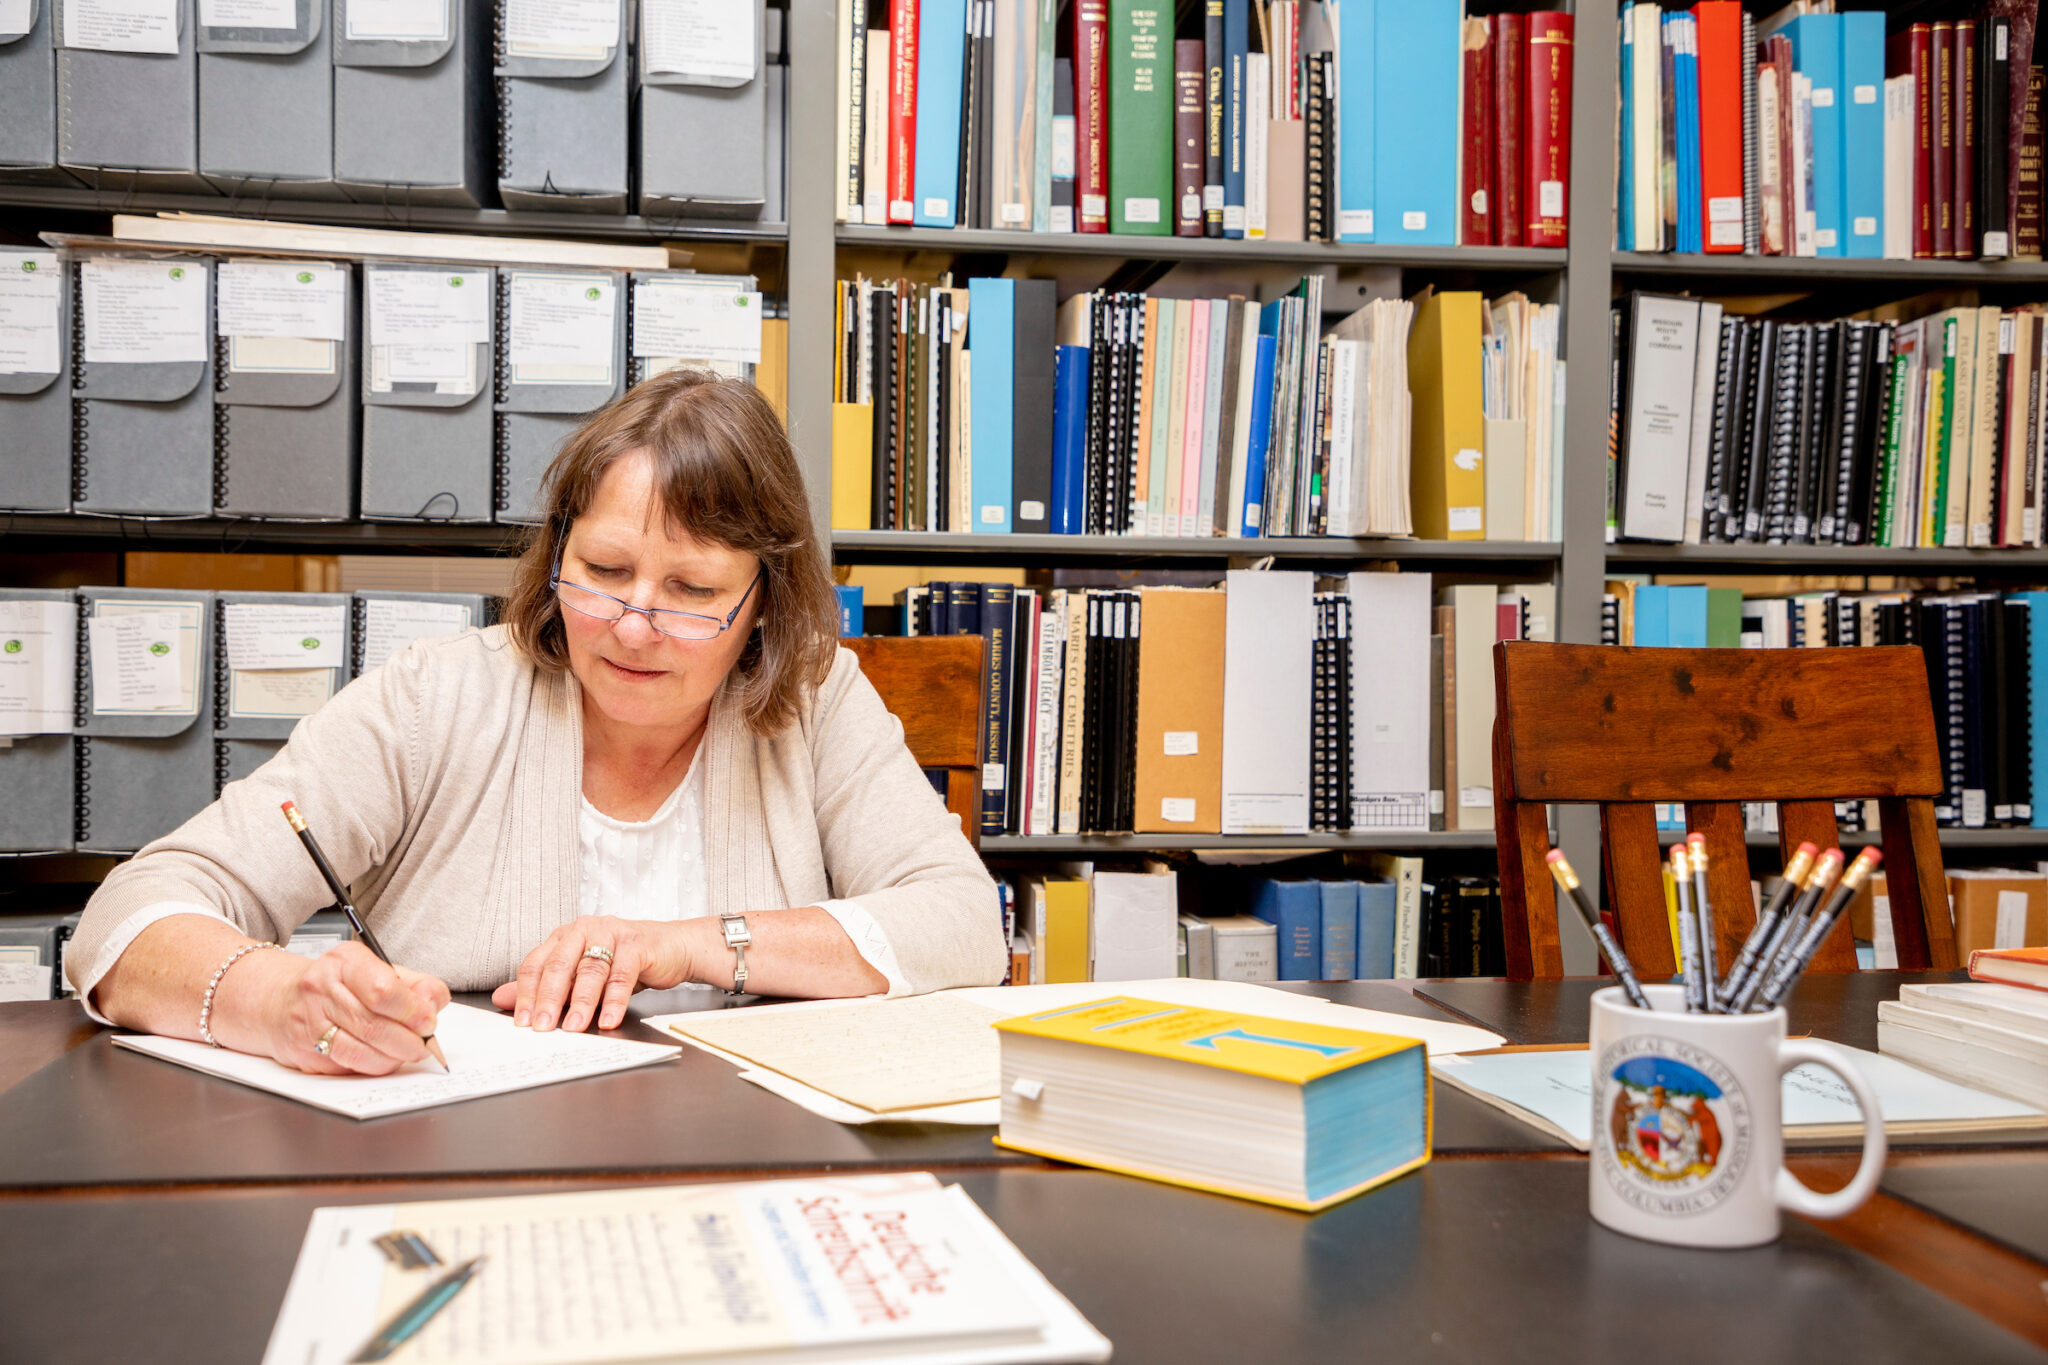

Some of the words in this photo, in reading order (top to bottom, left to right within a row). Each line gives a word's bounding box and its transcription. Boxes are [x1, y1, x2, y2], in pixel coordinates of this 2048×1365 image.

[1089, 27, 1101, 88] CRAWFORD
[1088, 89, 1101, 137] COUNTY,
[1089, 138, 1101, 189] MISSOURI
[1959, 336, 1970, 386] PULASKI
[1986, 331, 1996, 382] PULASKI
[1957, 391, 1968, 440] COUNTY
[1984, 385, 1994, 433] COUNTY
[991, 628, 1003, 670] MARIES
[1041, 623, 1055, 679] STEAMBOAT
[1070, 615, 1081, 664] MARIES
[989, 672, 1002, 719] COUNTY,
[1040, 681, 1053, 714] LEGACY
[1069, 667, 1079, 689] CO.
[989, 721, 1000, 764] MISSOU
[1065, 694, 1077, 778] CEMETERIES
[1402, 905, 1411, 941] Hundred
[1401, 943, 1410, 964] Years
[1675, 1043, 1740, 1096] SOCIETY
[1616, 1181, 1703, 1212] COLUMBIA
[862, 1208, 951, 1293] Deutsche
